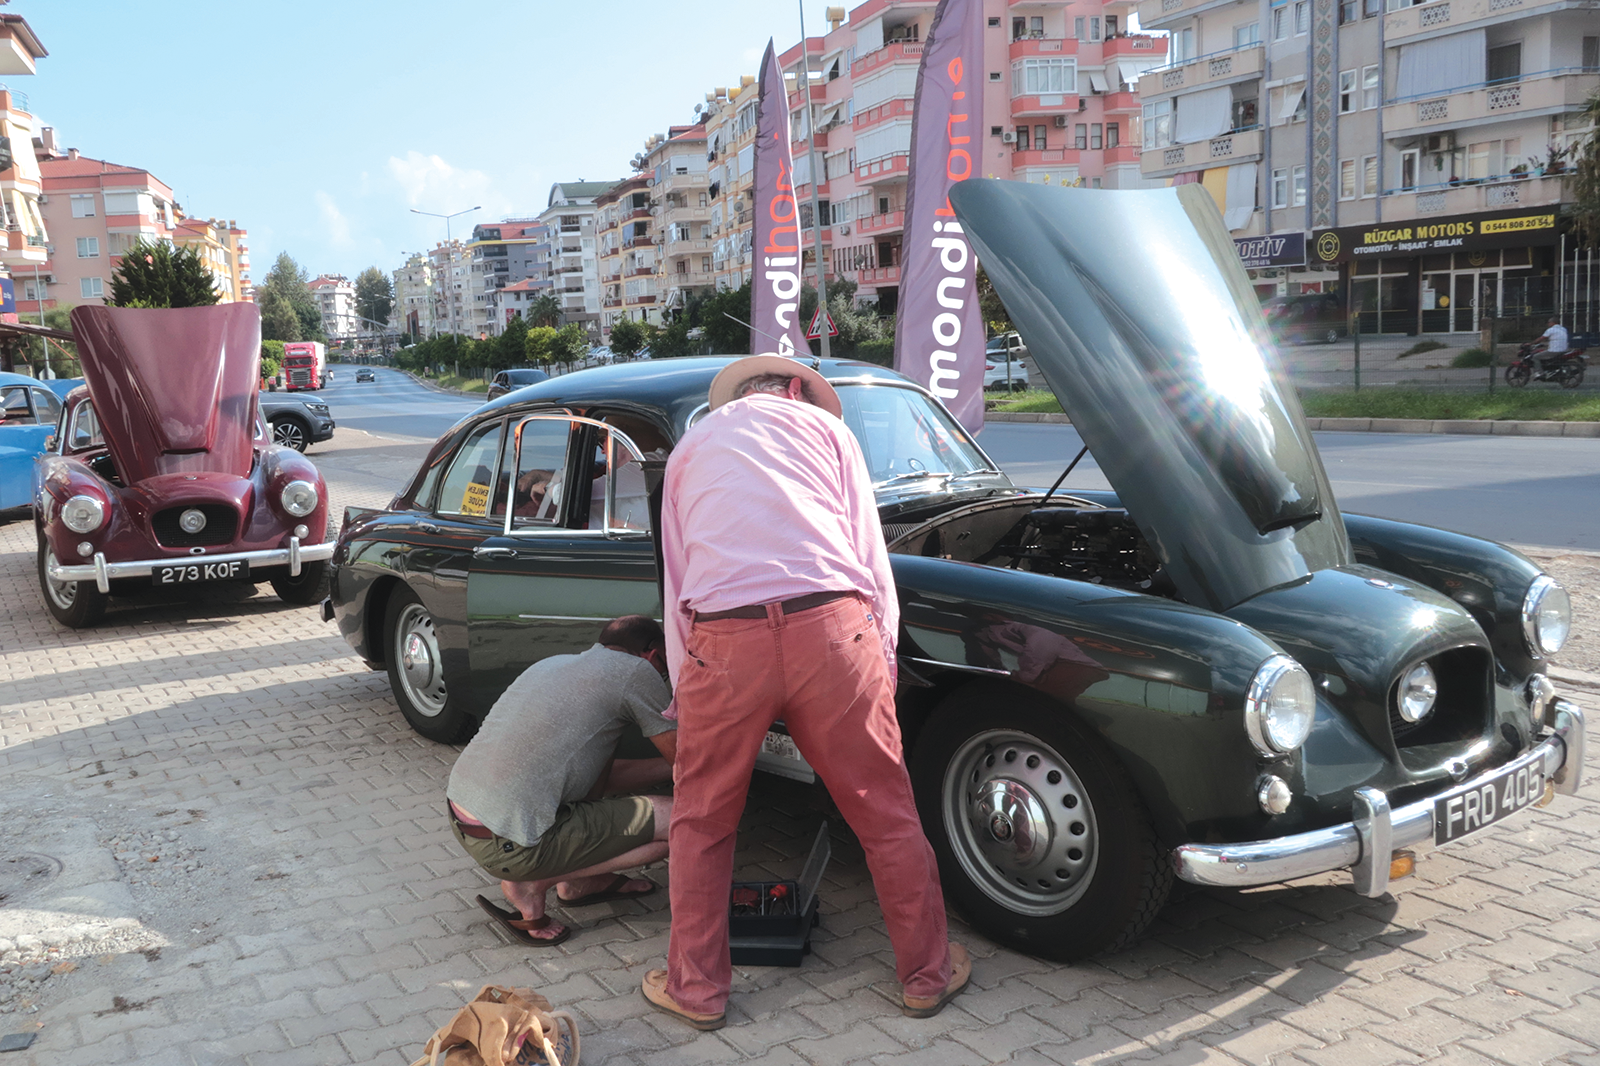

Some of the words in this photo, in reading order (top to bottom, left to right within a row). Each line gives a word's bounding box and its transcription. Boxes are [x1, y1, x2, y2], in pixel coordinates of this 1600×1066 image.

[1364, 228, 1412, 244] RÜZGAR
[1417, 221, 1475, 239] MOTORS
[1492, 222, 1507, 231] 544
[1509, 221, 1524, 229] 808
[1525, 219, 1536, 227] 20
[1235, 236, 1286, 259] OTİV
[1353, 243, 1394, 255] OTOMOTİV
[1398, 241, 1428, 251] İNŞAAT
[1433, 238, 1463, 248] EMLAK
[161, 566, 200, 583] 273
[204, 561, 241, 579] KOF
[1446, 784, 1497, 839] FRD
[1502, 760, 1541, 811] 405
